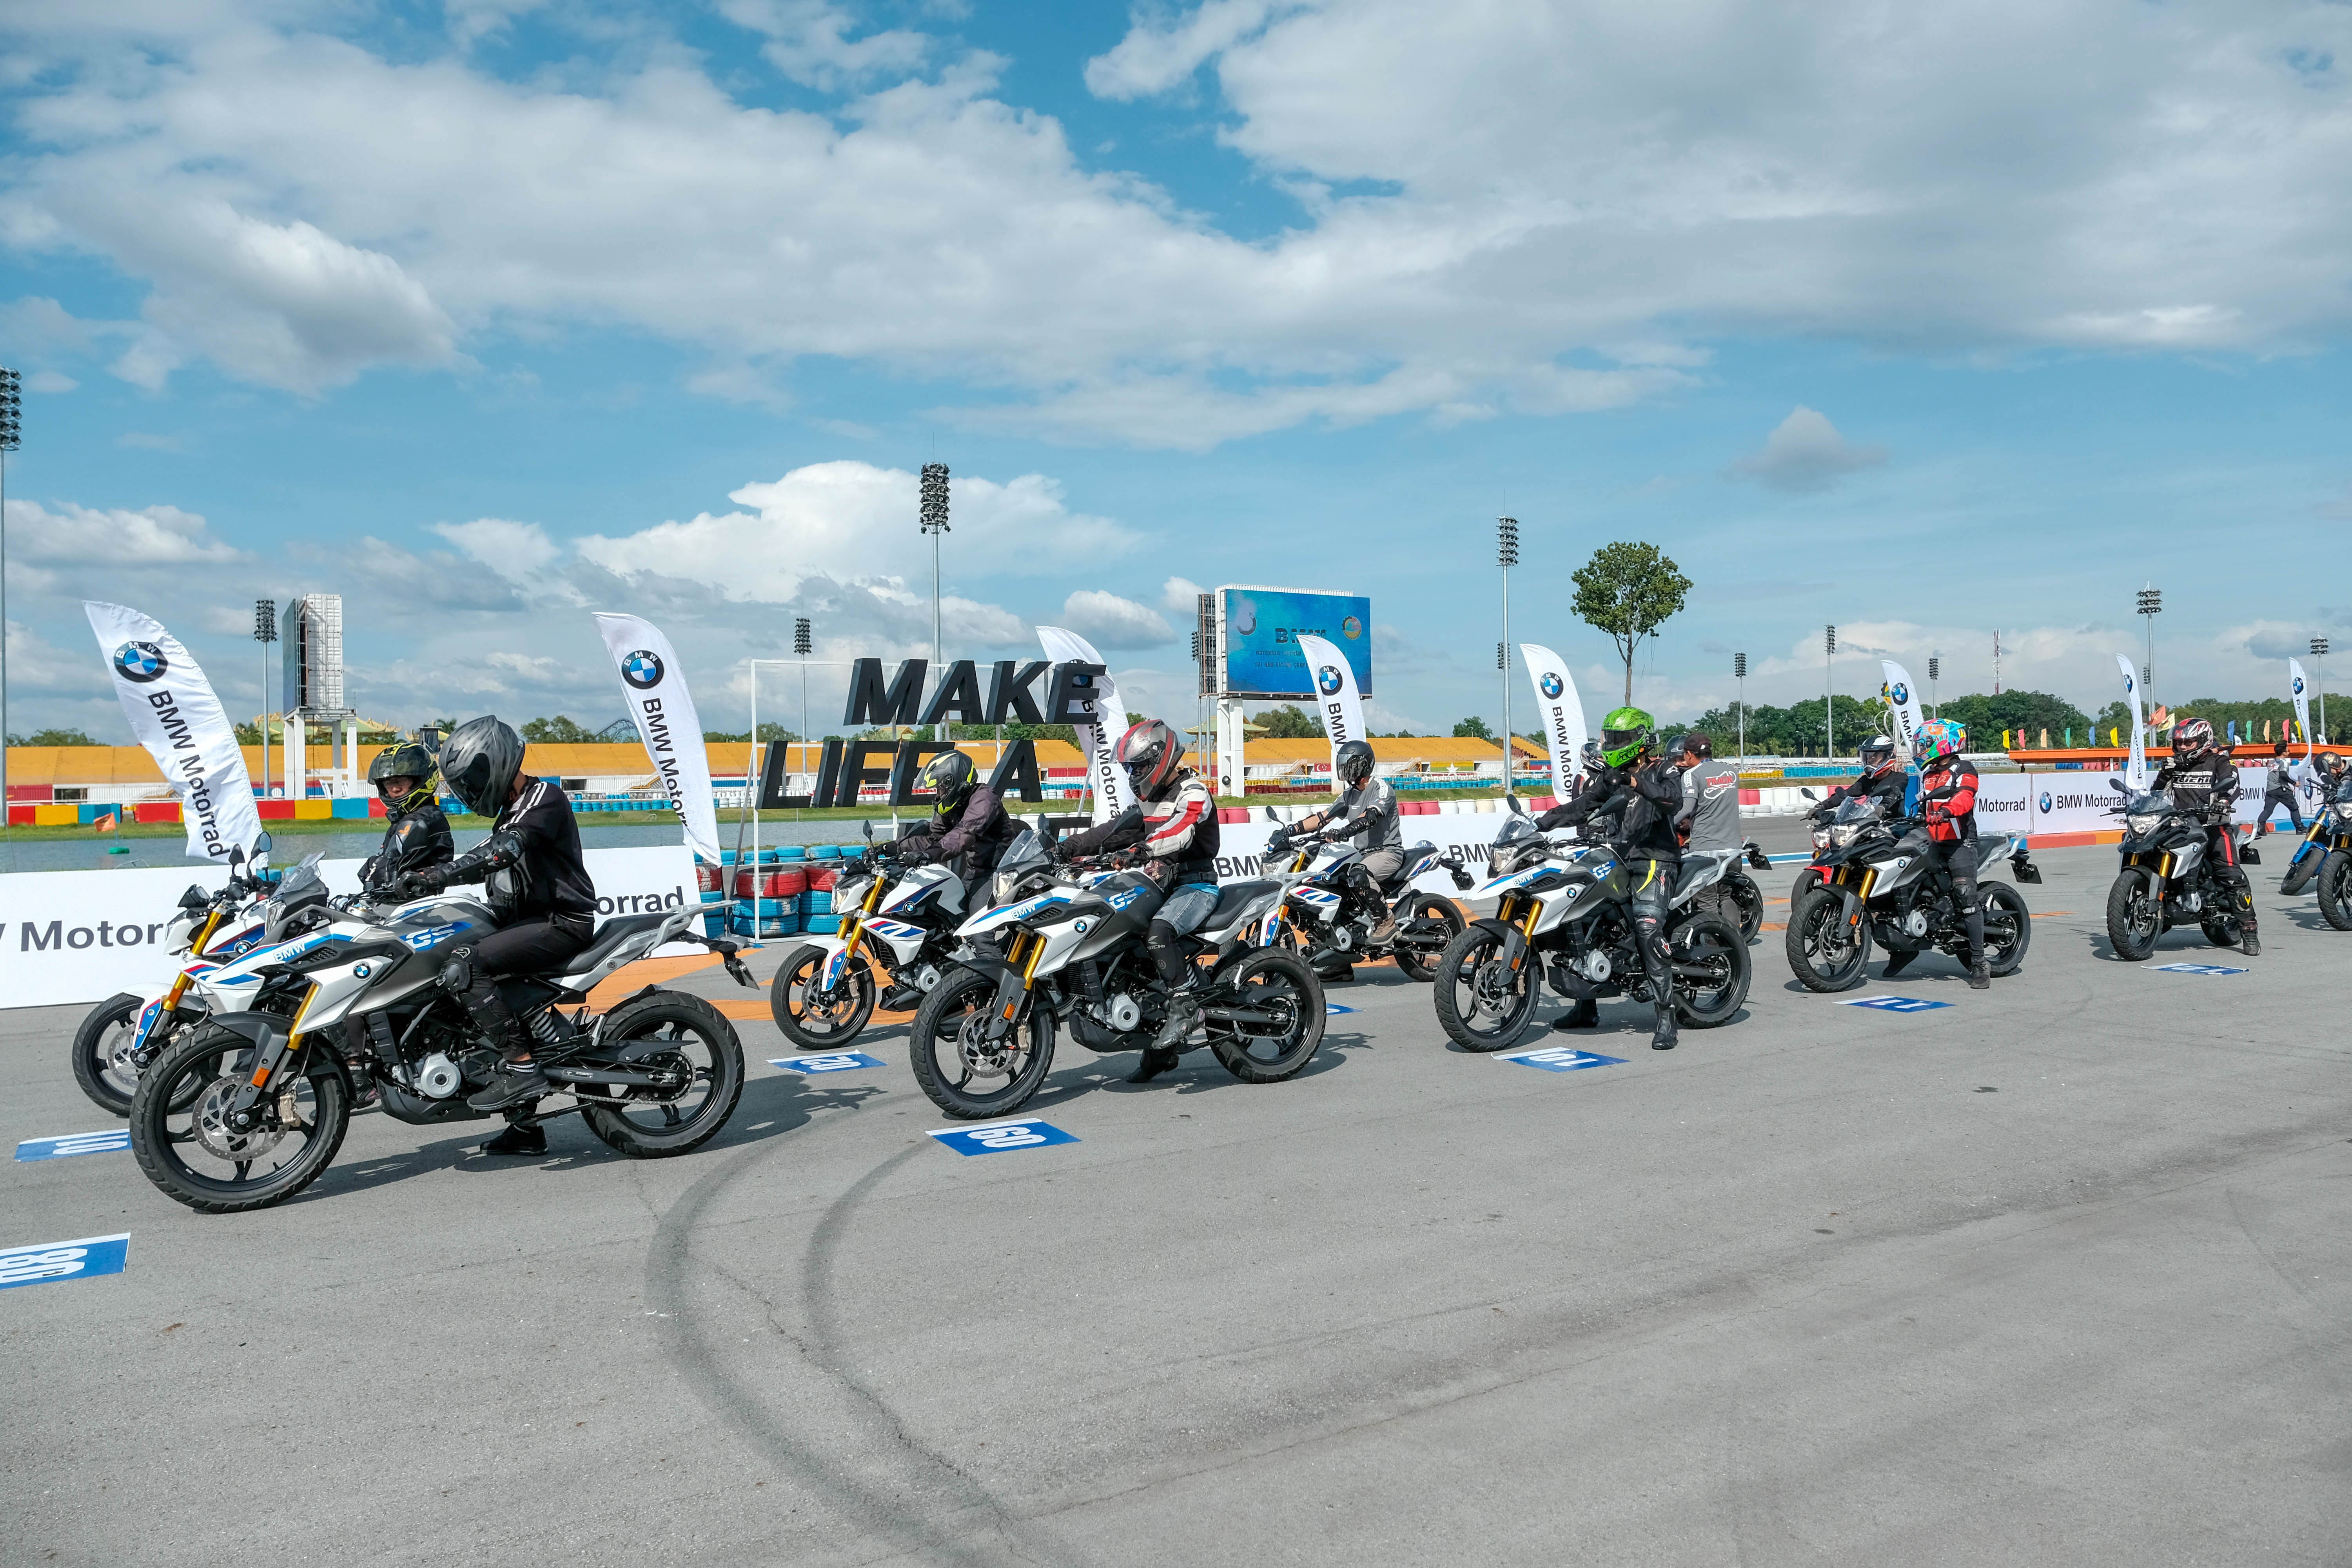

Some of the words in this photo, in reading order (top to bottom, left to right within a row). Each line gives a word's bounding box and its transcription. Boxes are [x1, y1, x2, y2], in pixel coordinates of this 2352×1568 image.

[116, 642, 157, 659] BMW
[624, 651, 659, 666] BMW
[1541, 673, 1560, 683] BMW
[843, 658, 1107, 726] MAKE
[1328, 702, 1348, 745] BMW
[1552, 706, 1568, 745] BMW
[148, 690, 196, 750] BMW
[179, 754, 230, 857] Motorrad
[642, 698, 673, 752] BMW
[659, 758, 688, 828] Motorr
[1559, 750, 1573, 797] Motor
[755, 740, 956, 810] LIFE
[987, 740, 1043, 803] A
[1097, 748, 1121, 819] Motorra
[1706, 776, 1733, 787] TRACK
[1978, 797, 2025, 812] Motorrad
[2057, 795, 2082, 809] BMW
[2085, 794, 2127, 808] Motorrad
[2239, 788, 2259, 800] BMW
[1513, 873, 1533, 886] BMW
[1593, 862, 1612, 879] GS
[596, 886, 684, 915] orrad
[1109, 888, 1138, 909] GS
[1011, 902, 1035, 919] BMW
[21, 920, 164, 952] Motor
[405, 923, 456, 949] GS
[273, 941, 306, 962] BMW
[1869, 1000, 1929, 1009] 11
